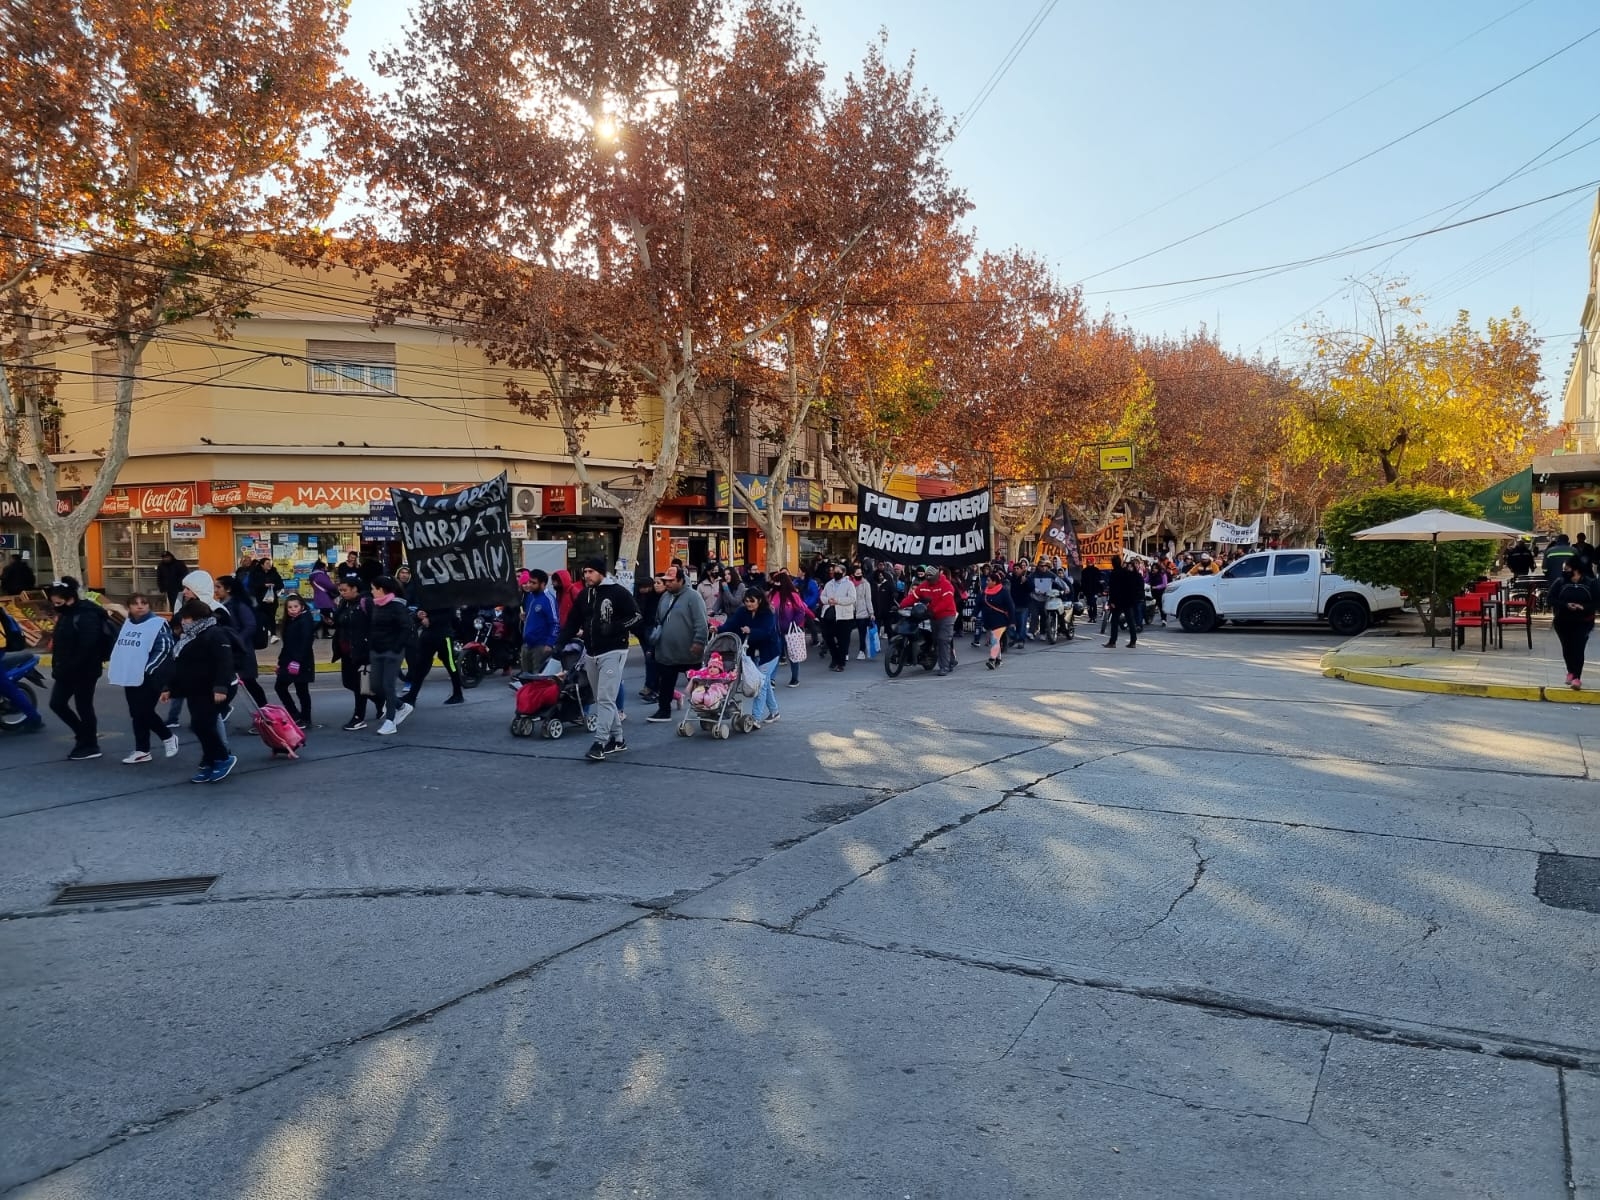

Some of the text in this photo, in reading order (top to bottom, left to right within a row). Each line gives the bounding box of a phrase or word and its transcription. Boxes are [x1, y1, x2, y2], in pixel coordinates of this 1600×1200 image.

[142, 487, 188, 514] Coca-Cola
[297, 487, 424, 501] MAXIKIOSO
[2, 501, 24, 517] PAL
[864, 492, 919, 522] POLO
[927, 491, 990, 522] OBRERO
[858, 522, 985, 556] BARRIO COLÓN
[1104, 524, 1120, 541] DE
[720, 538, 745, 559] OULET
